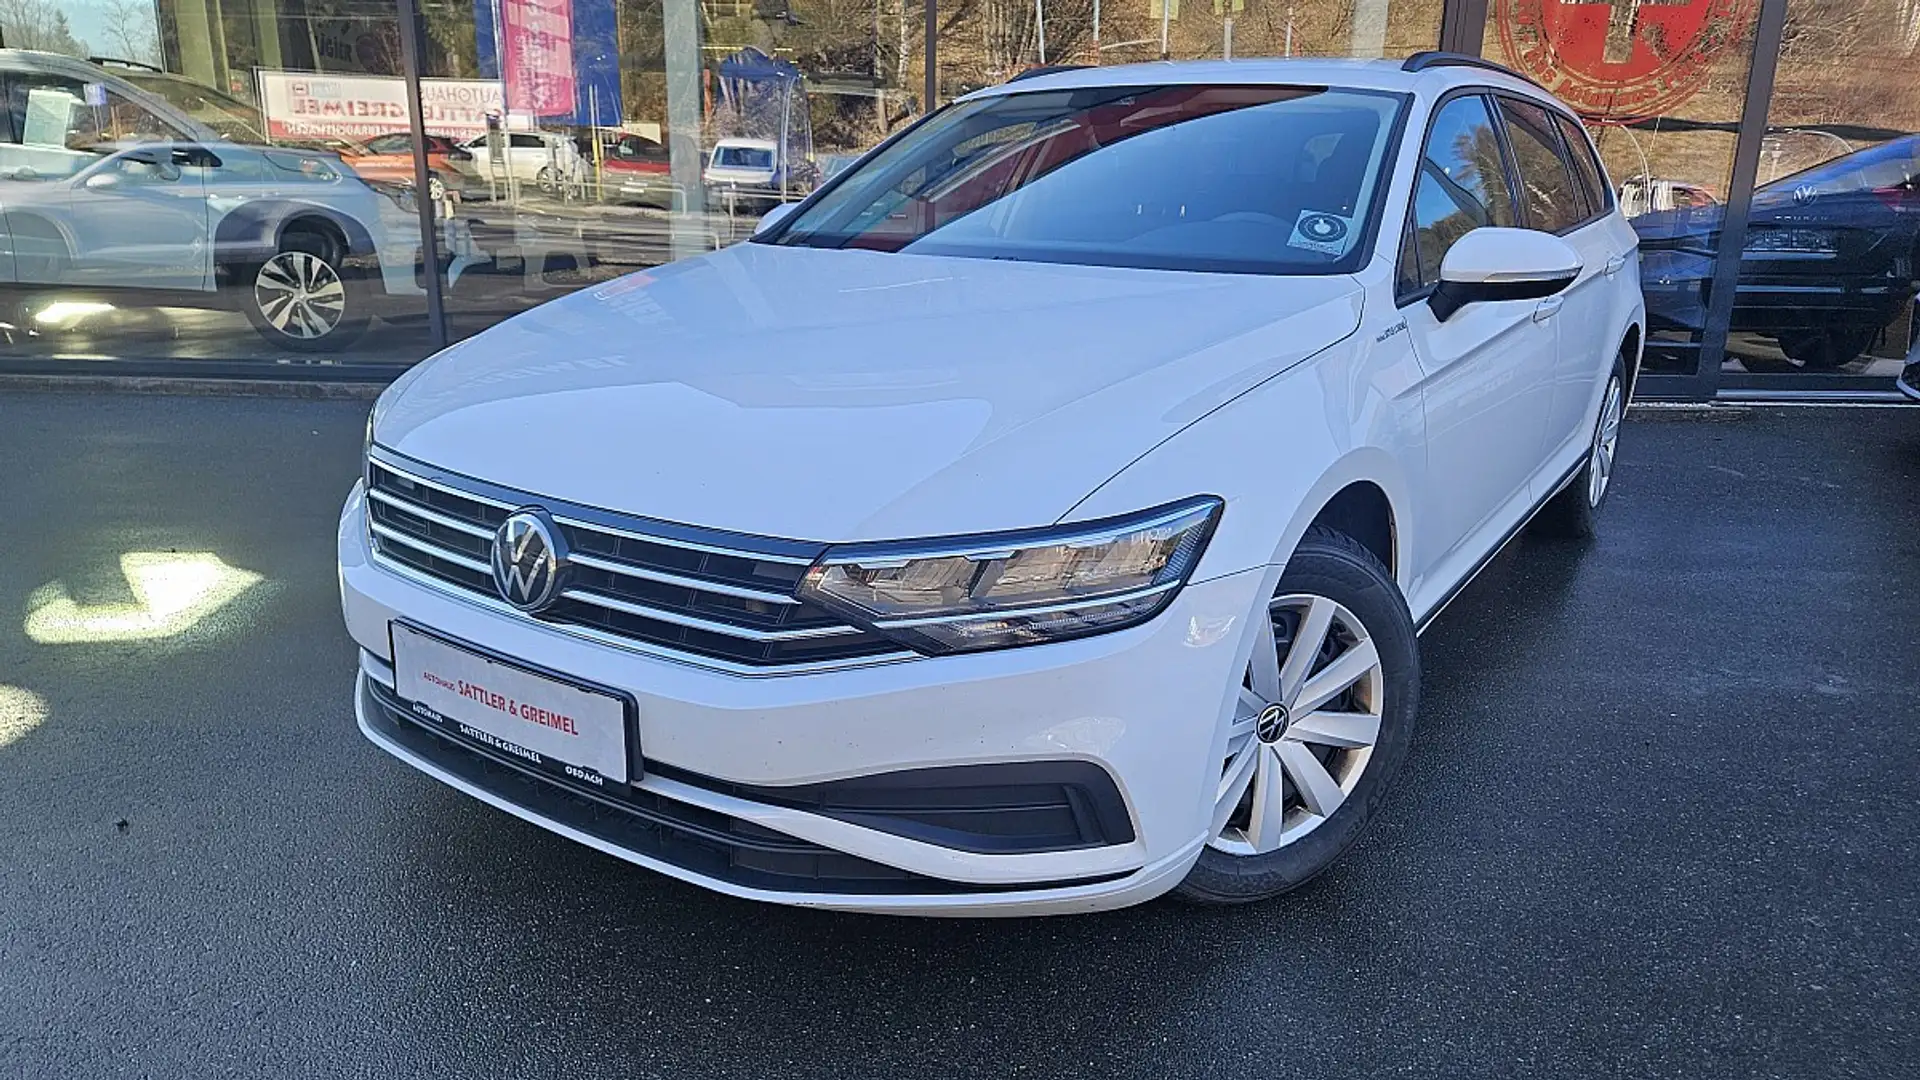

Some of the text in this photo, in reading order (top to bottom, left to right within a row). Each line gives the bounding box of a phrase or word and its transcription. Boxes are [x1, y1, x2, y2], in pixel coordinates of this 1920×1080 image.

[423, 671, 579, 736] AUTOHAUS SATTLER & GREIMEL
[412, 703, 443, 723] AUTOHAUS
[459, 724, 495, 747] SATTLER
[502, 741, 542, 764] GREIMEL
[564, 765, 604, 787] OBDACH
